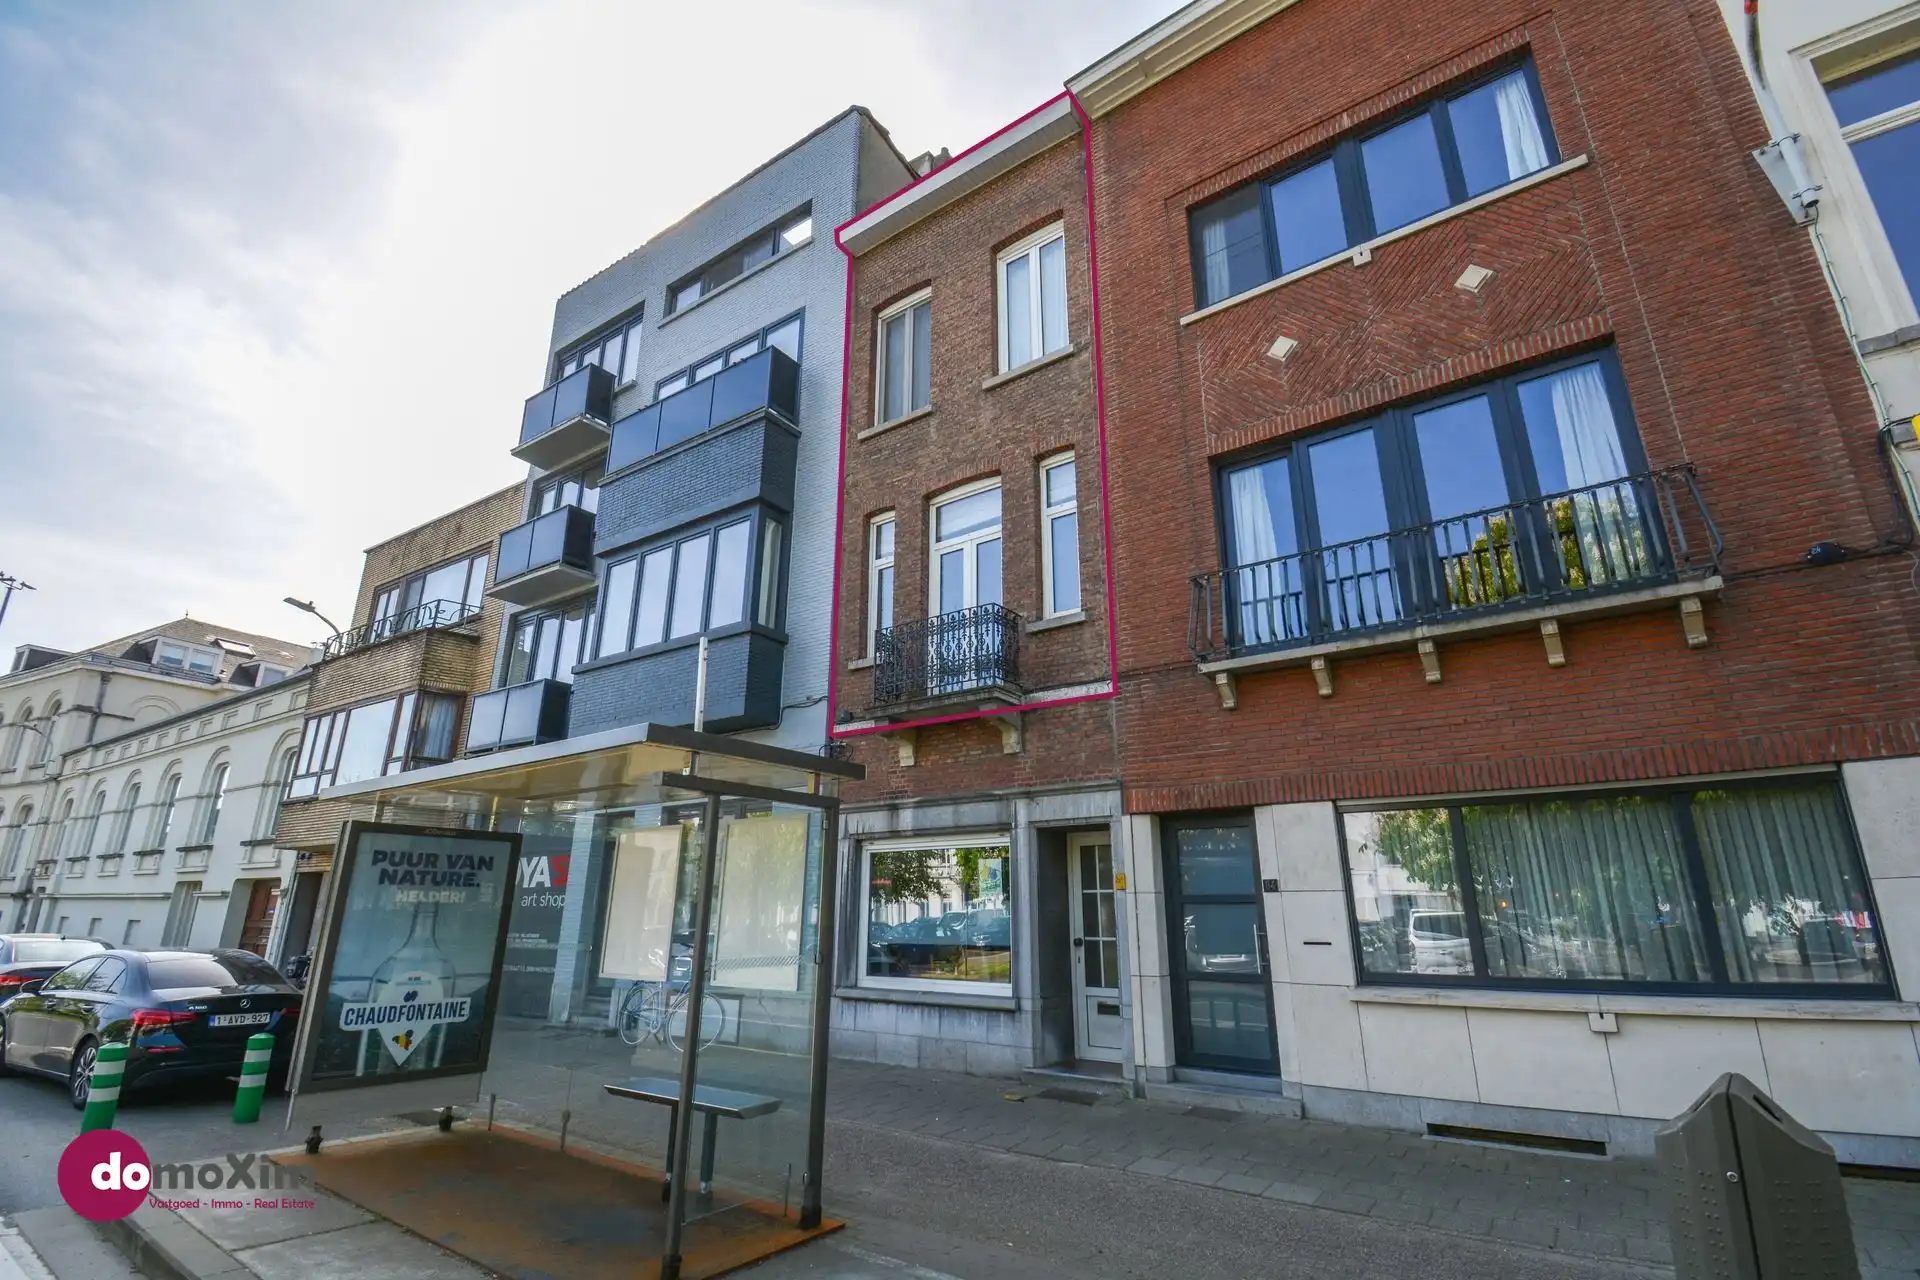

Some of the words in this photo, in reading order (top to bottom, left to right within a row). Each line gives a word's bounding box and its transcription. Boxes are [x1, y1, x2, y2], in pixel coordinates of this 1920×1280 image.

[372, 849, 440, 868] PUUR
[446, 855, 494, 871] VAN
[378, 868, 480, 887] NATURE.
[521, 894, 536, 907] art
[343, 1001, 466, 1026] CHAUDFONTAINE
